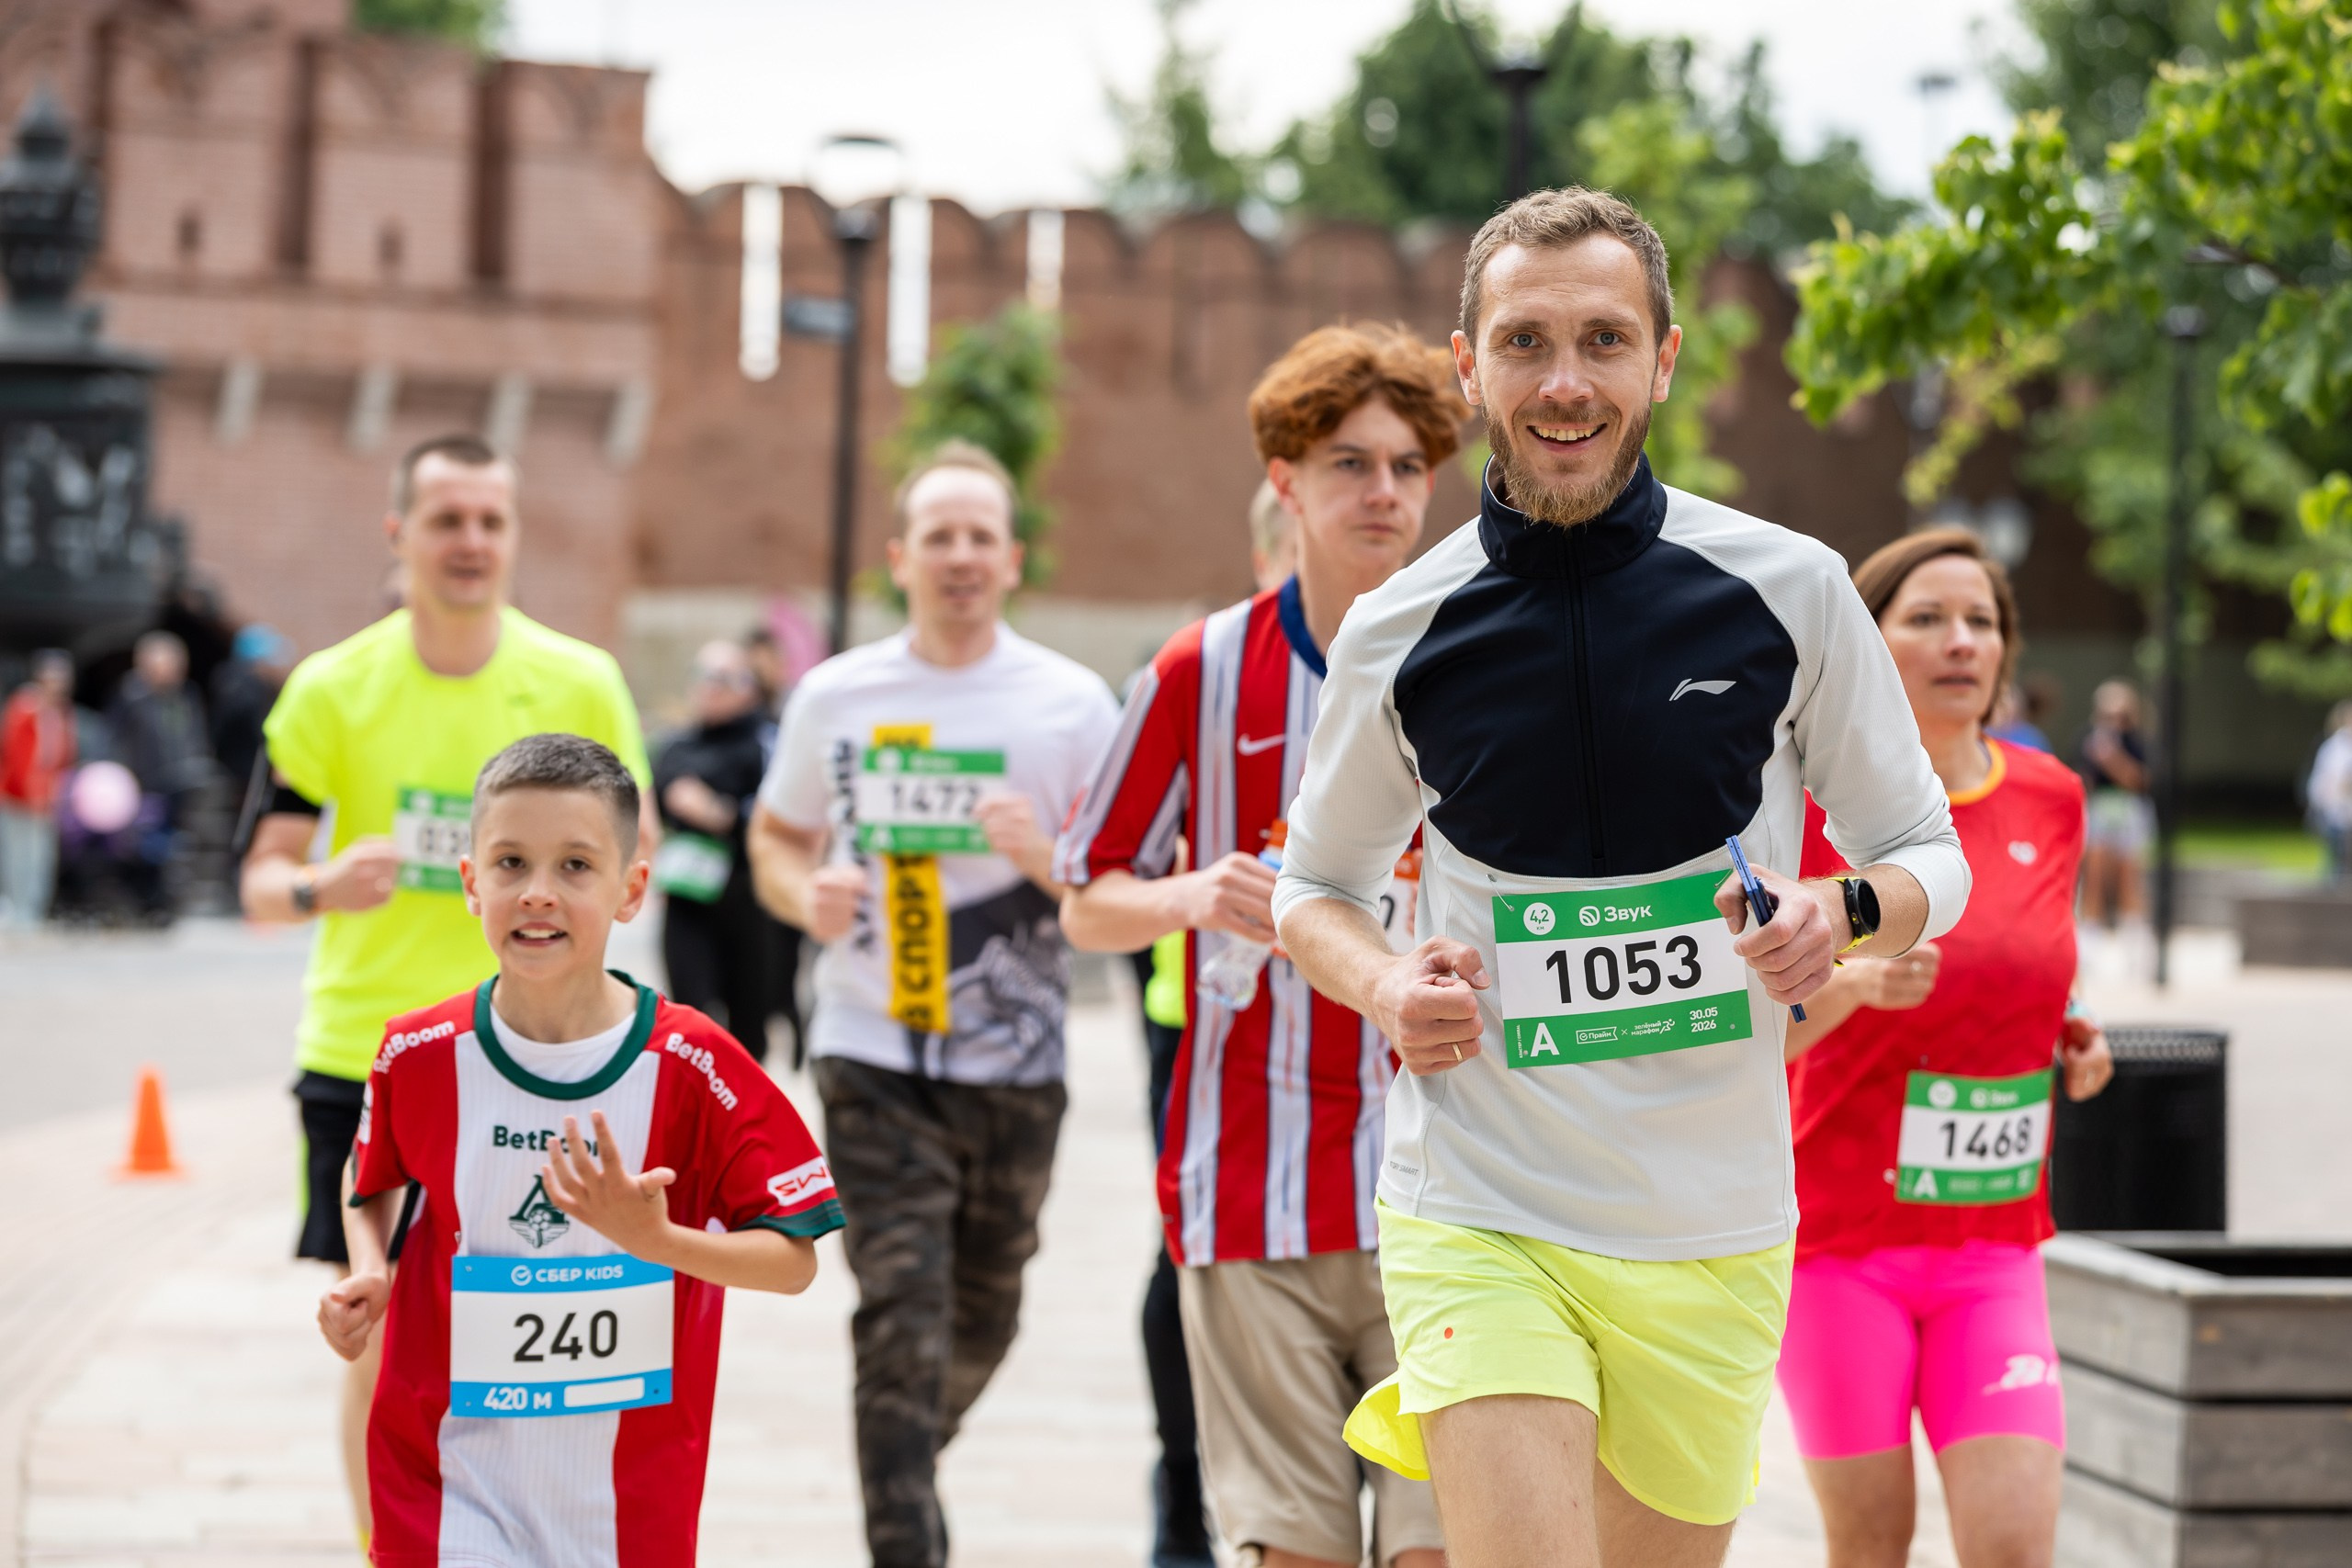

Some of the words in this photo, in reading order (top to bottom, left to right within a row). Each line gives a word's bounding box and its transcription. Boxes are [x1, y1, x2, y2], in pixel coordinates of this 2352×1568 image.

[1530, 909, 1550, 925] 4,2
[1603, 905, 1653, 923] Звук
[1545, 935, 1702, 1004] 1053
[1690, 1007, 1719, 1021] 30.05
[1631, 1027, 1660, 1037] марафон
[1634, 1021, 1662, 1031] зелёный
[1690, 1020, 1717, 1033] 2026
[1530, 1022, 1560, 1057] A
[1589, 1031, 1612, 1040] Прайм
[1939, 1117, 2033, 1158] 1468
[535, 1268, 582, 1283] СБЕР
[584, 1264, 624, 1280] KIDS
[513, 1310, 618, 1362] 240
[482, 1387, 528, 1411] 420
